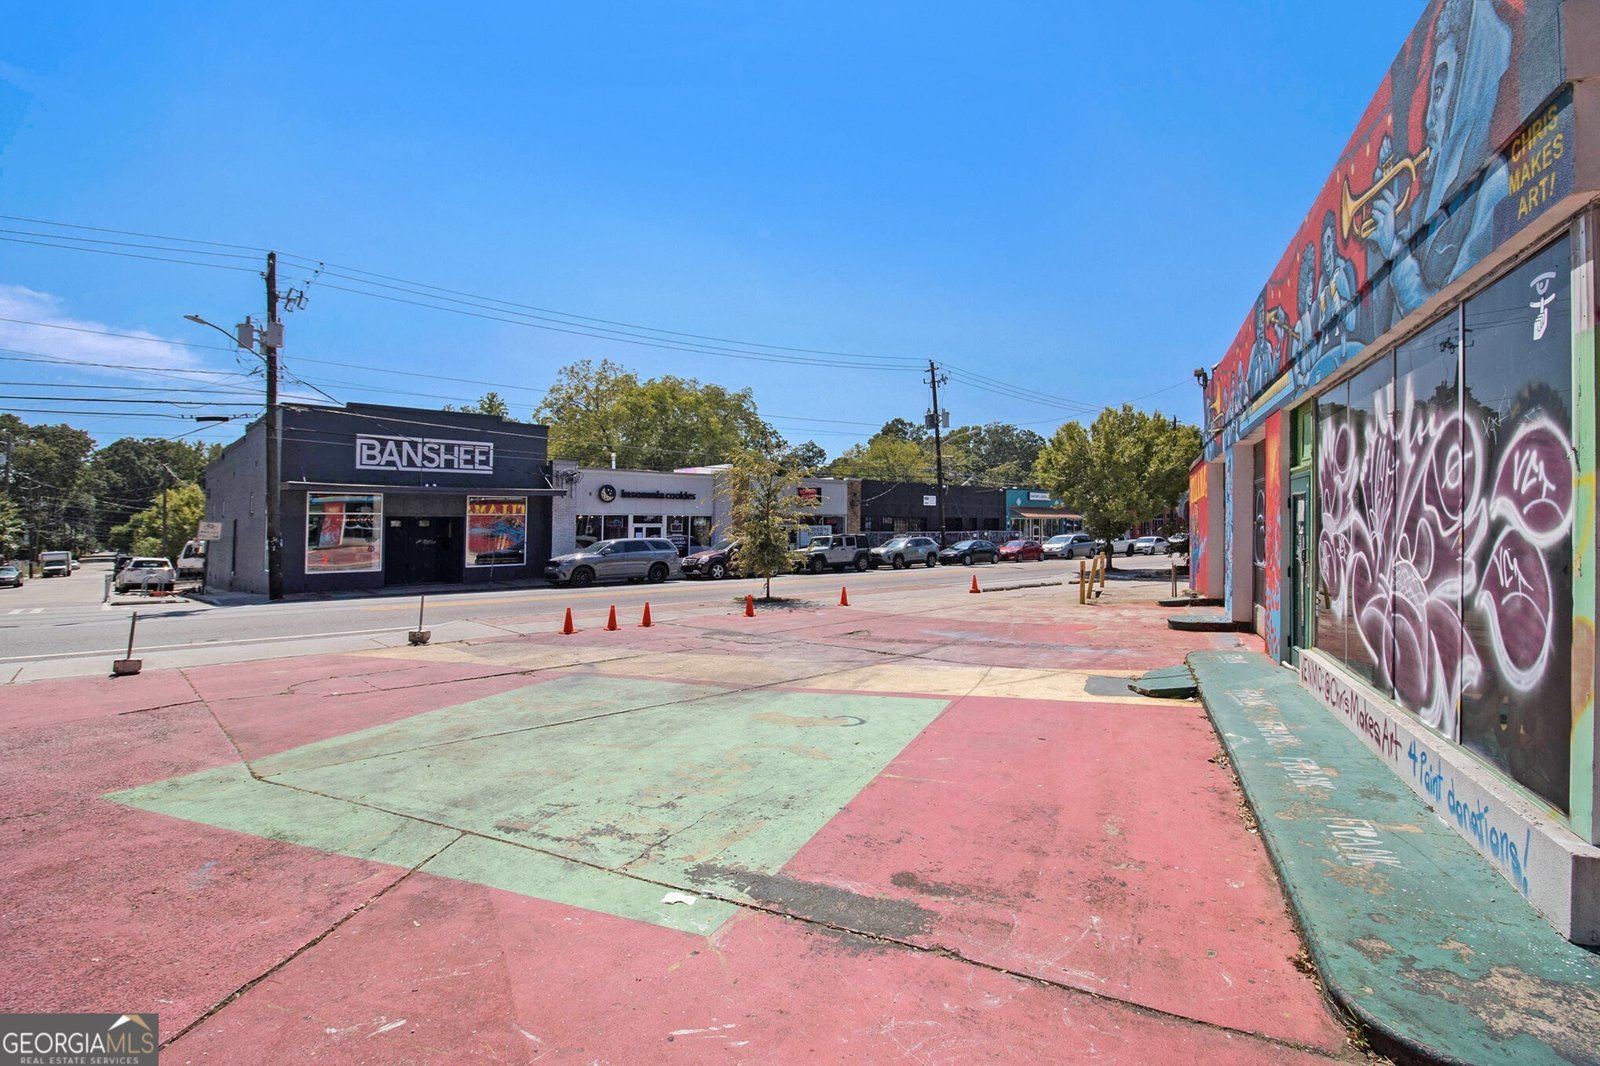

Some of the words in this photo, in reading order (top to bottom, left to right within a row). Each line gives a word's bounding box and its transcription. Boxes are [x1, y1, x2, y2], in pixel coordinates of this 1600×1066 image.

[1511, 104, 1558, 162] CHRIS
[1509, 133, 1564, 196] MAKES
[1517, 171, 1556, 221] ART!
[359, 437, 493, 472] BANSHEE
[1407, 738, 1418, 777] 4
[1419, 750, 1444, 803] Paint
[1447, 777, 1531, 898] donations!
